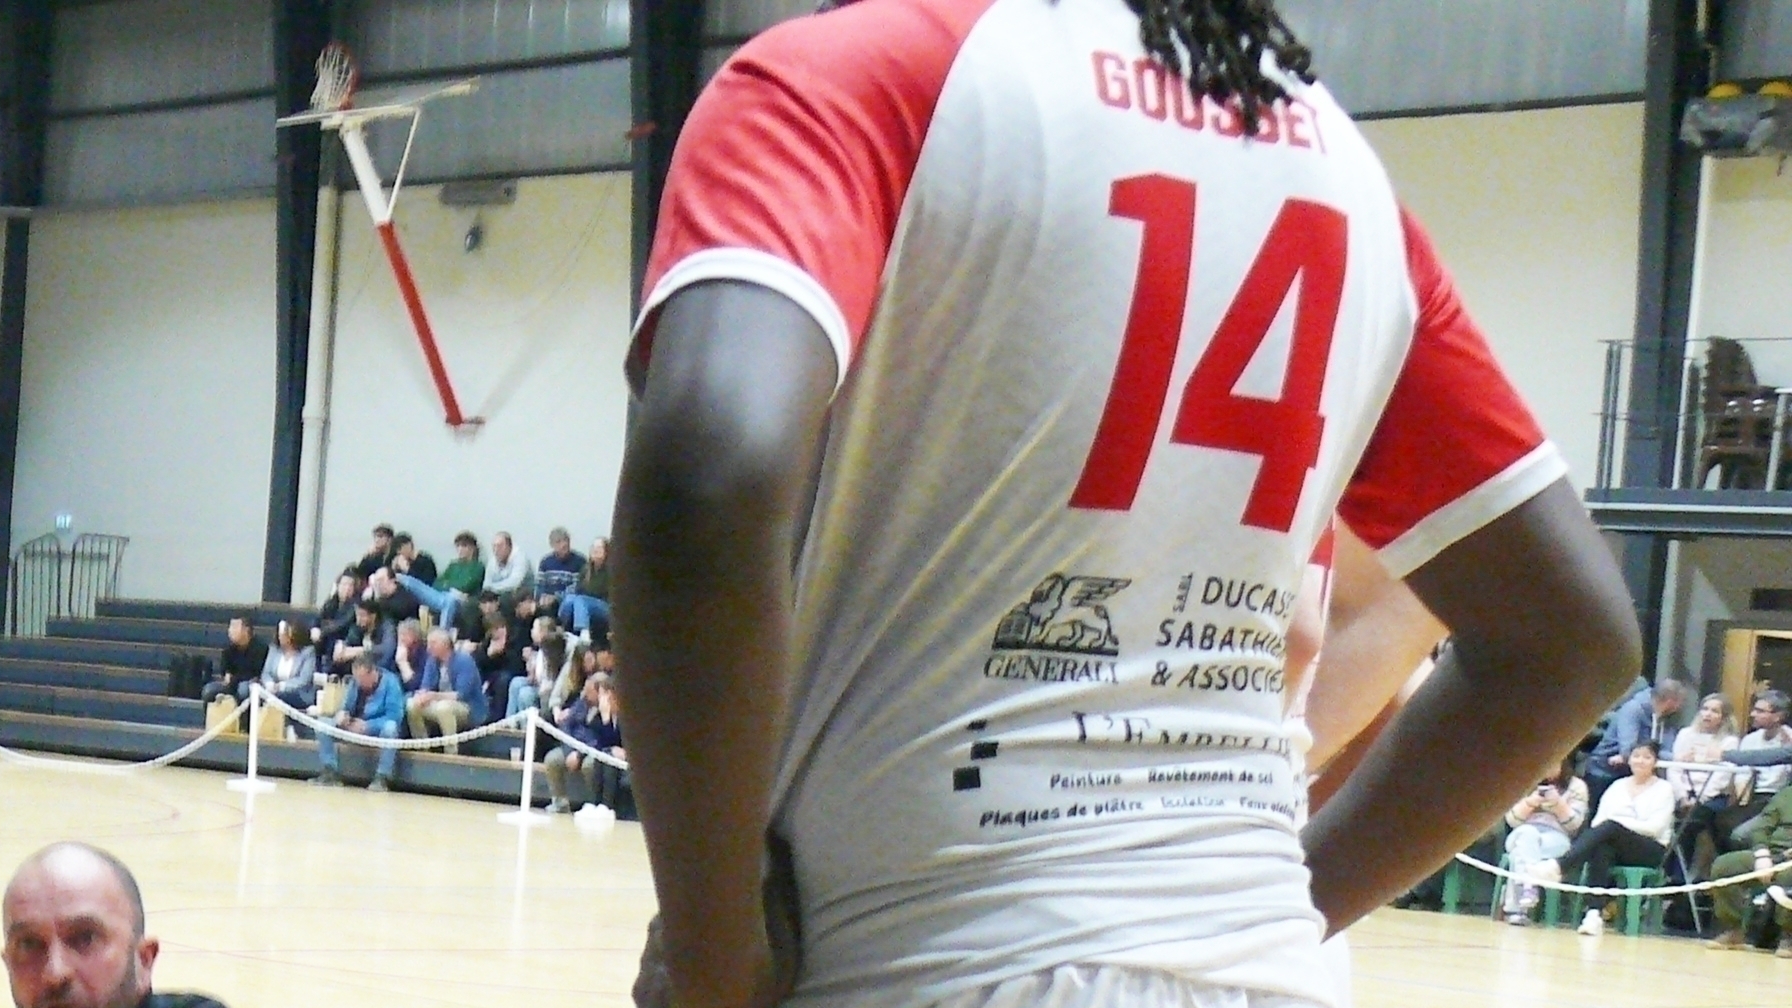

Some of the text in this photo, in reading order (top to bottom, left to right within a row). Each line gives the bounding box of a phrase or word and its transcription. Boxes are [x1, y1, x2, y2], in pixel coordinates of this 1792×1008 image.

[1068, 172, 1349, 533] 14
[983, 655, 1119, 683] GENERALI
[1151, 661, 1173, 687] &
[1050, 773, 1122, 790] Peinture
[979, 807, 1060, 828] Plaques
[1067, 803, 1087, 817] de
